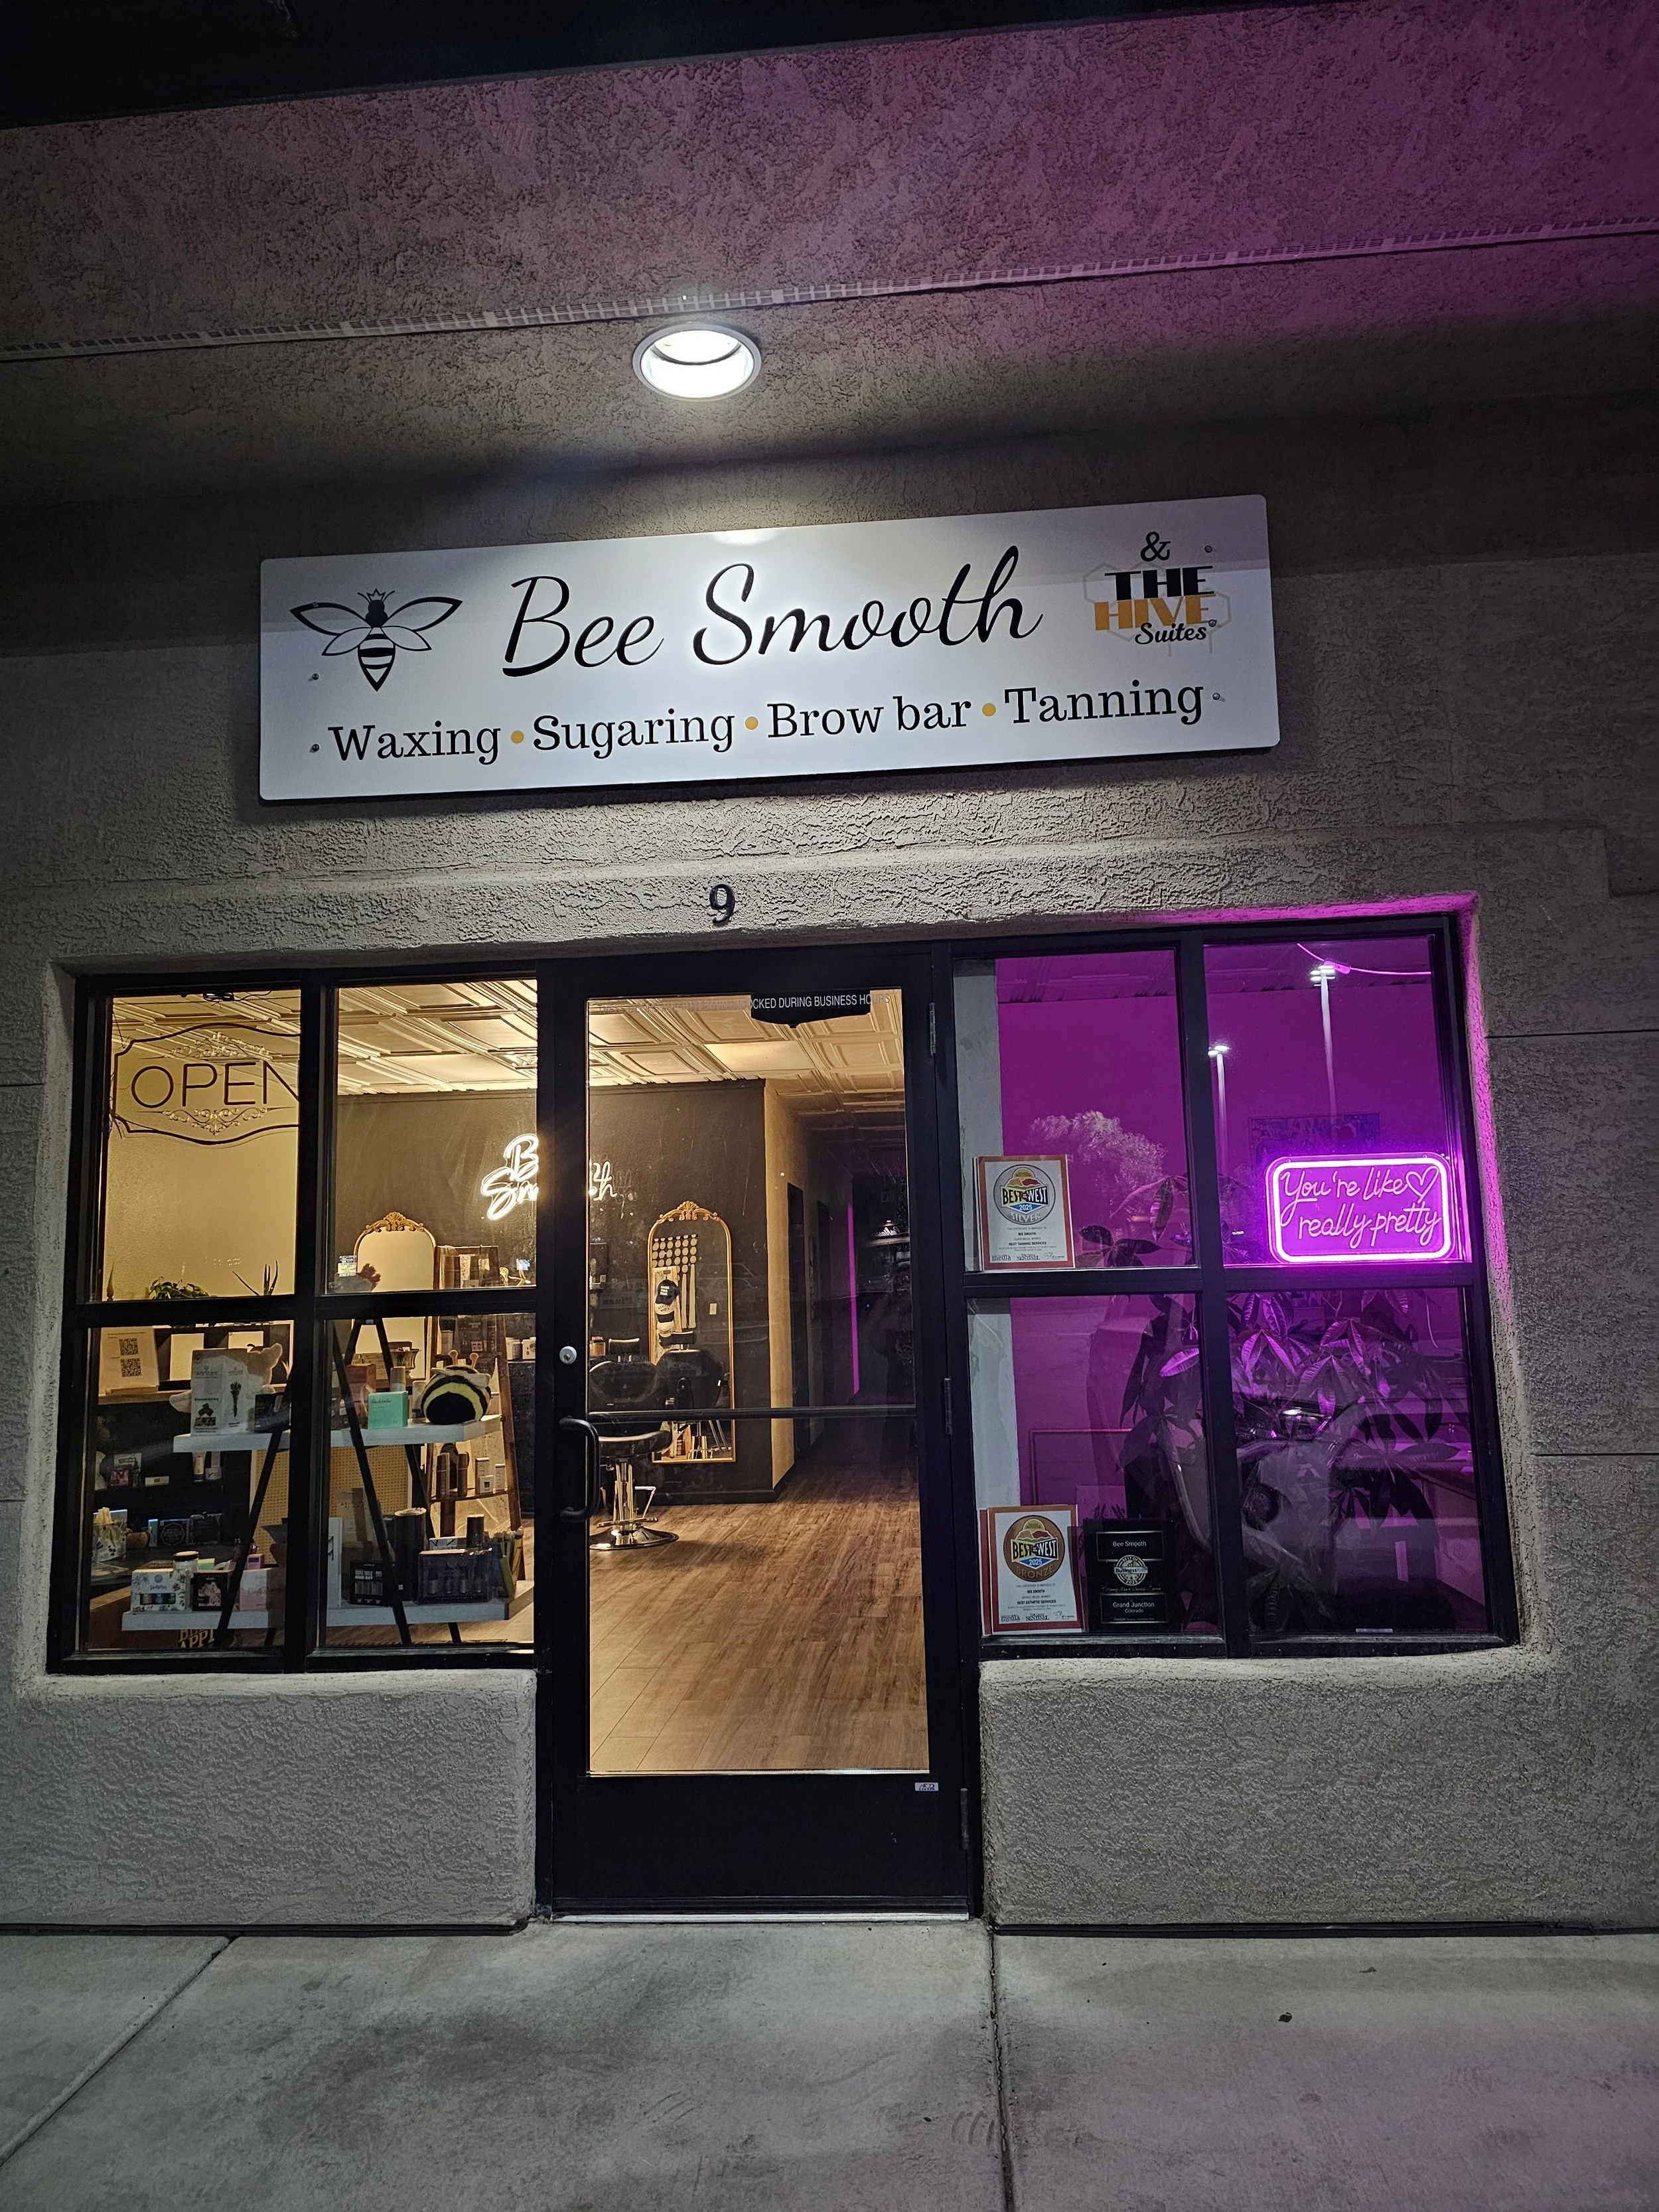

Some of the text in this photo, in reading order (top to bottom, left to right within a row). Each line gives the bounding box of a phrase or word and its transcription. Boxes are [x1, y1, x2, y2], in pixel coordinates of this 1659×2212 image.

[1141, 532, 1171, 561] &
[1105, 565, 1214, 601] THE
[502, 546, 1043, 678] Bee Smooth
[1095, 595, 1216, 630] HIVE
[1135, 623, 1207, 644] Suites
[328, 680, 1204, 765] Waxing Sugaring Brow bar Tanning
[709, 883, 736, 923] 9
[778, 996, 812, 1008] DURING
[814, 994, 857, 1007] BUSINESS
[131, 1060, 299, 1108] OPEN
[1002, 1187, 1046, 1205] BEST WEST
[1280, 1167, 1409, 1227] You're like
[1011, 1212, 1041, 1222] SILVER
[1299, 1201, 1442, 1248] really pretty
[1013, 1540, 1056, 1560] BEST WEST
[1016, 1564, 1054, 1579] BRONZE
